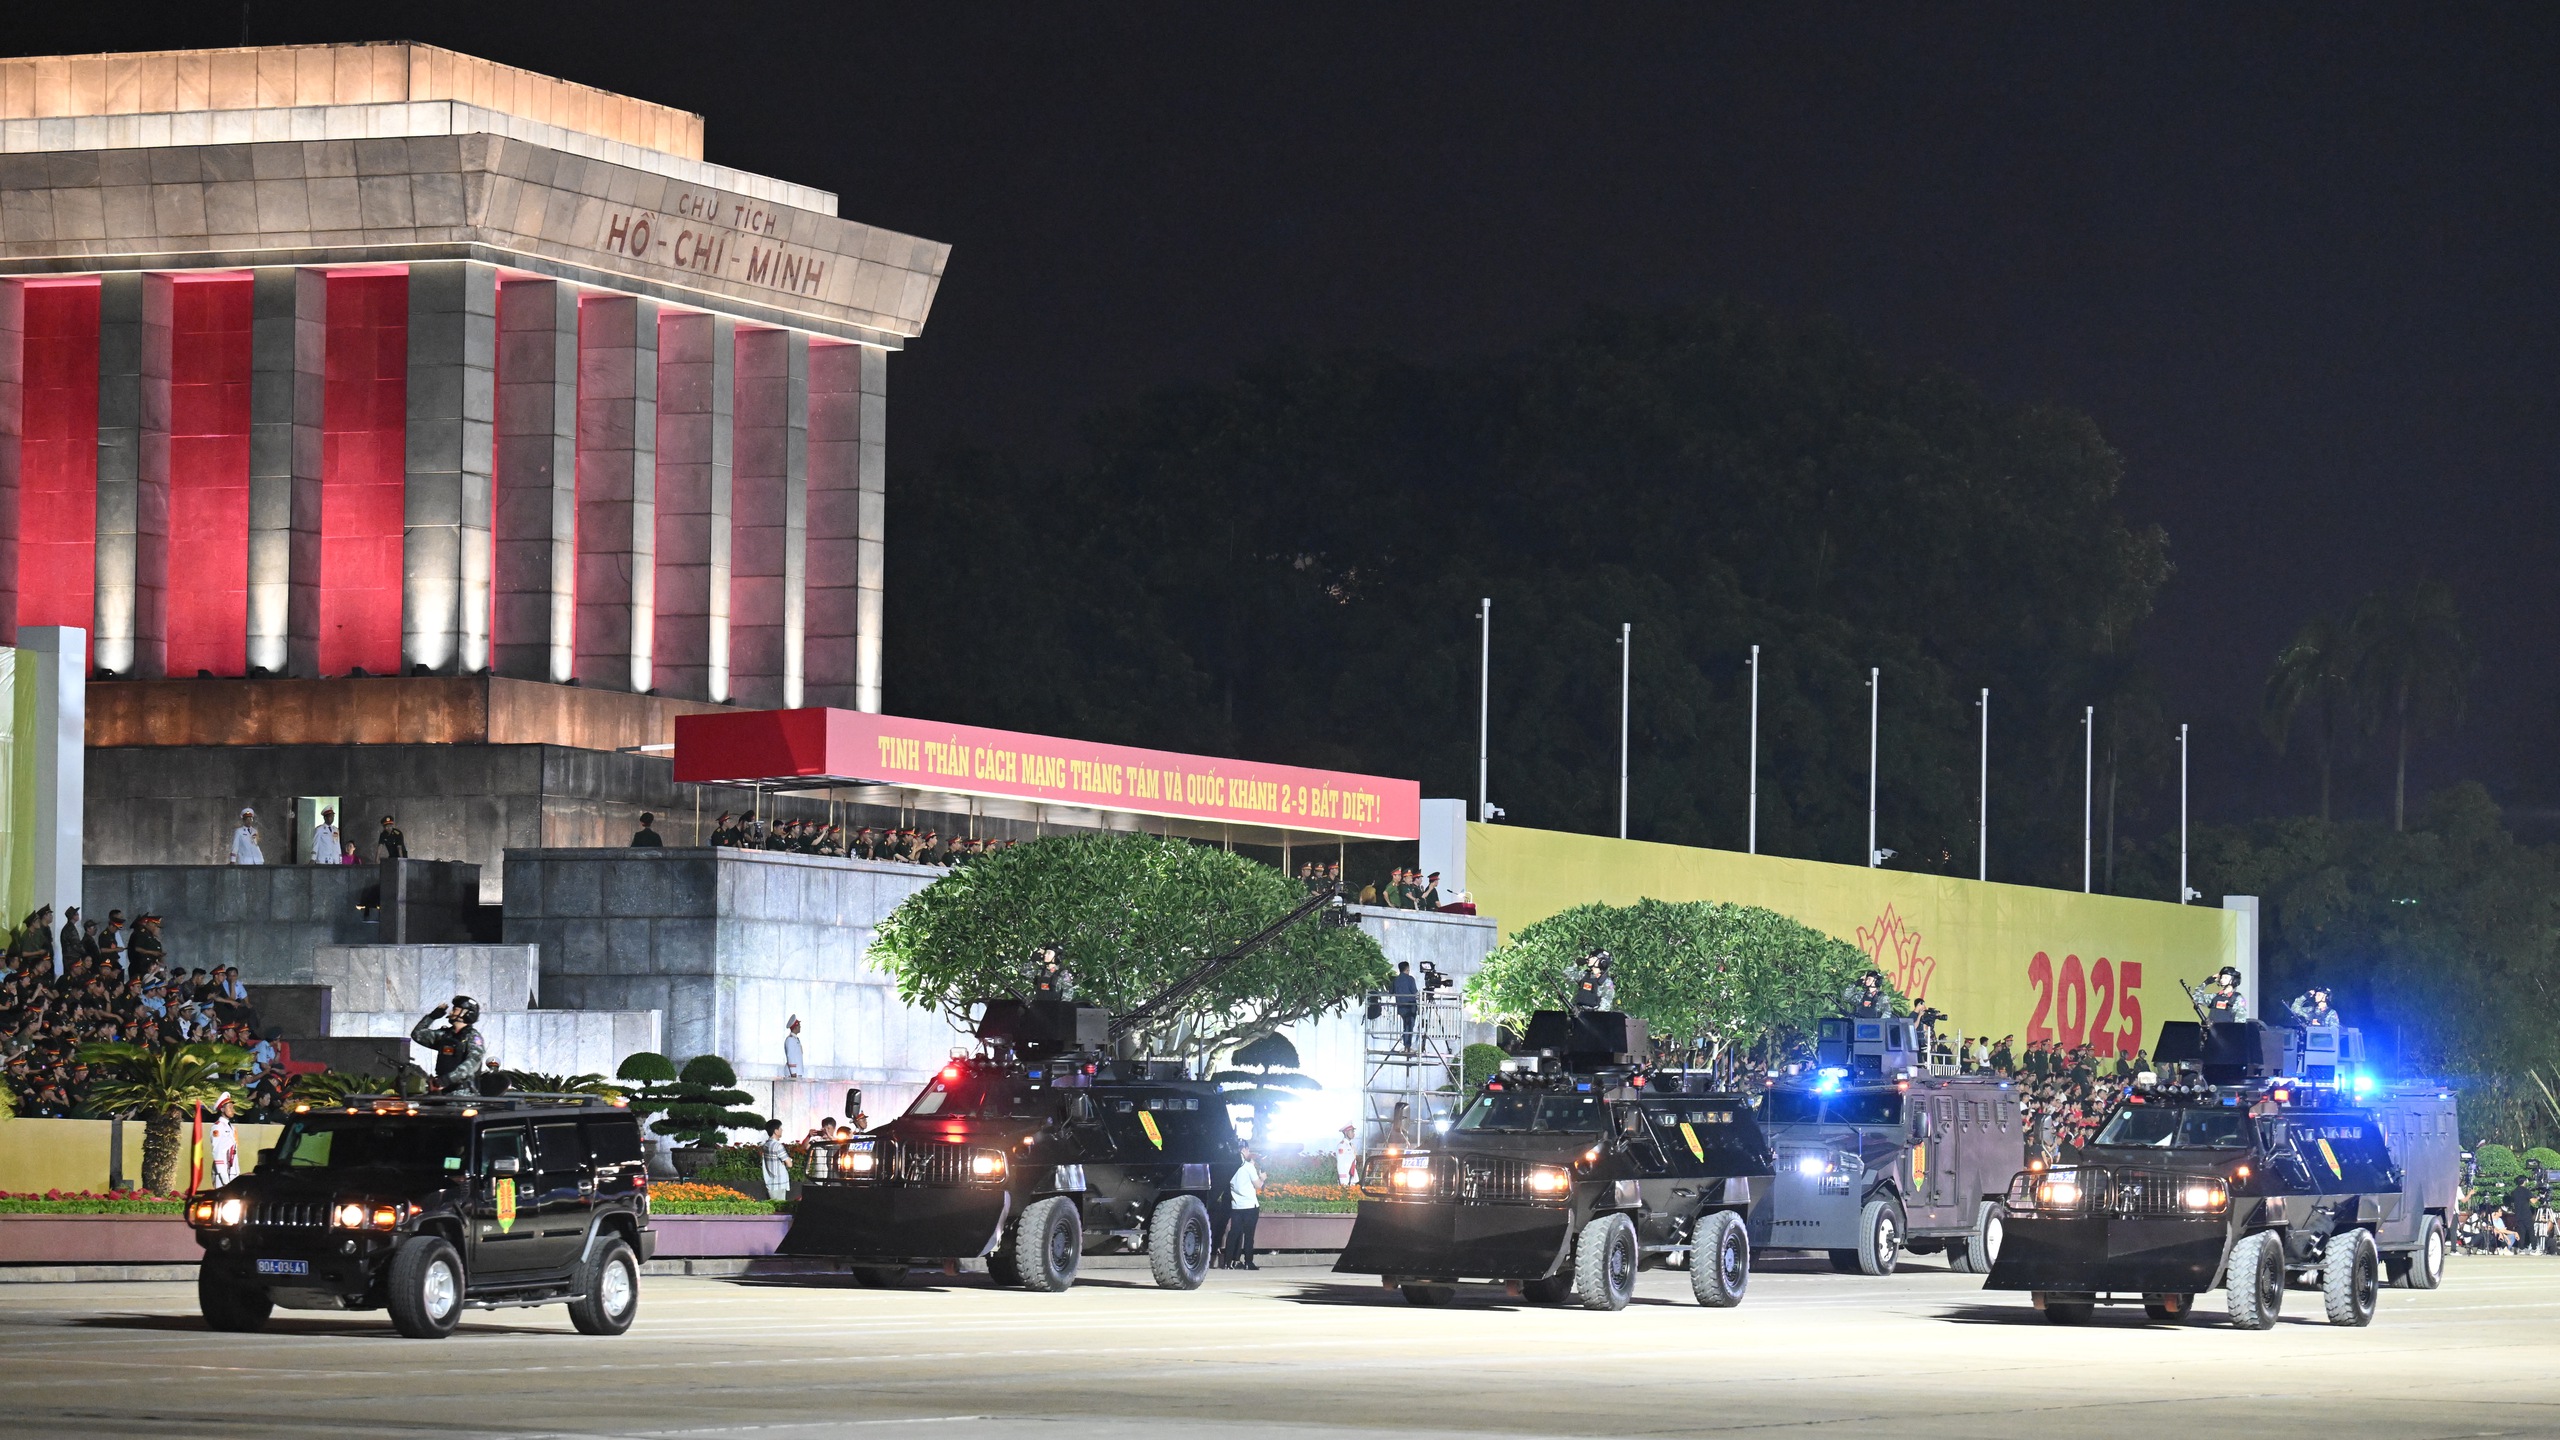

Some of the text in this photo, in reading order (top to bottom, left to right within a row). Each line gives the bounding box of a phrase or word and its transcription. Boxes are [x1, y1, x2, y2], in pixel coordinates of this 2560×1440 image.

[878, 735, 920, 771] TINH
[924, 733, 970, 777] THẦN
[974, 742, 1017, 783] CÁCH
[1021, 753, 1066, 792] MẠNG
[1070, 755, 1122, 796] THÁNG
[1126, 761, 1160, 799] TÁM
[1163, 765, 1183, 802] VÀ
[1187, 766, 1225, 807] QUỐC
[1228, 774, 1278, 812] KHÁNH
[1281, 783, 1307, 816] 2-9
[1310, 780, 1339, 819] BẤT
[2026, 951, 2143, 1062] 2025
